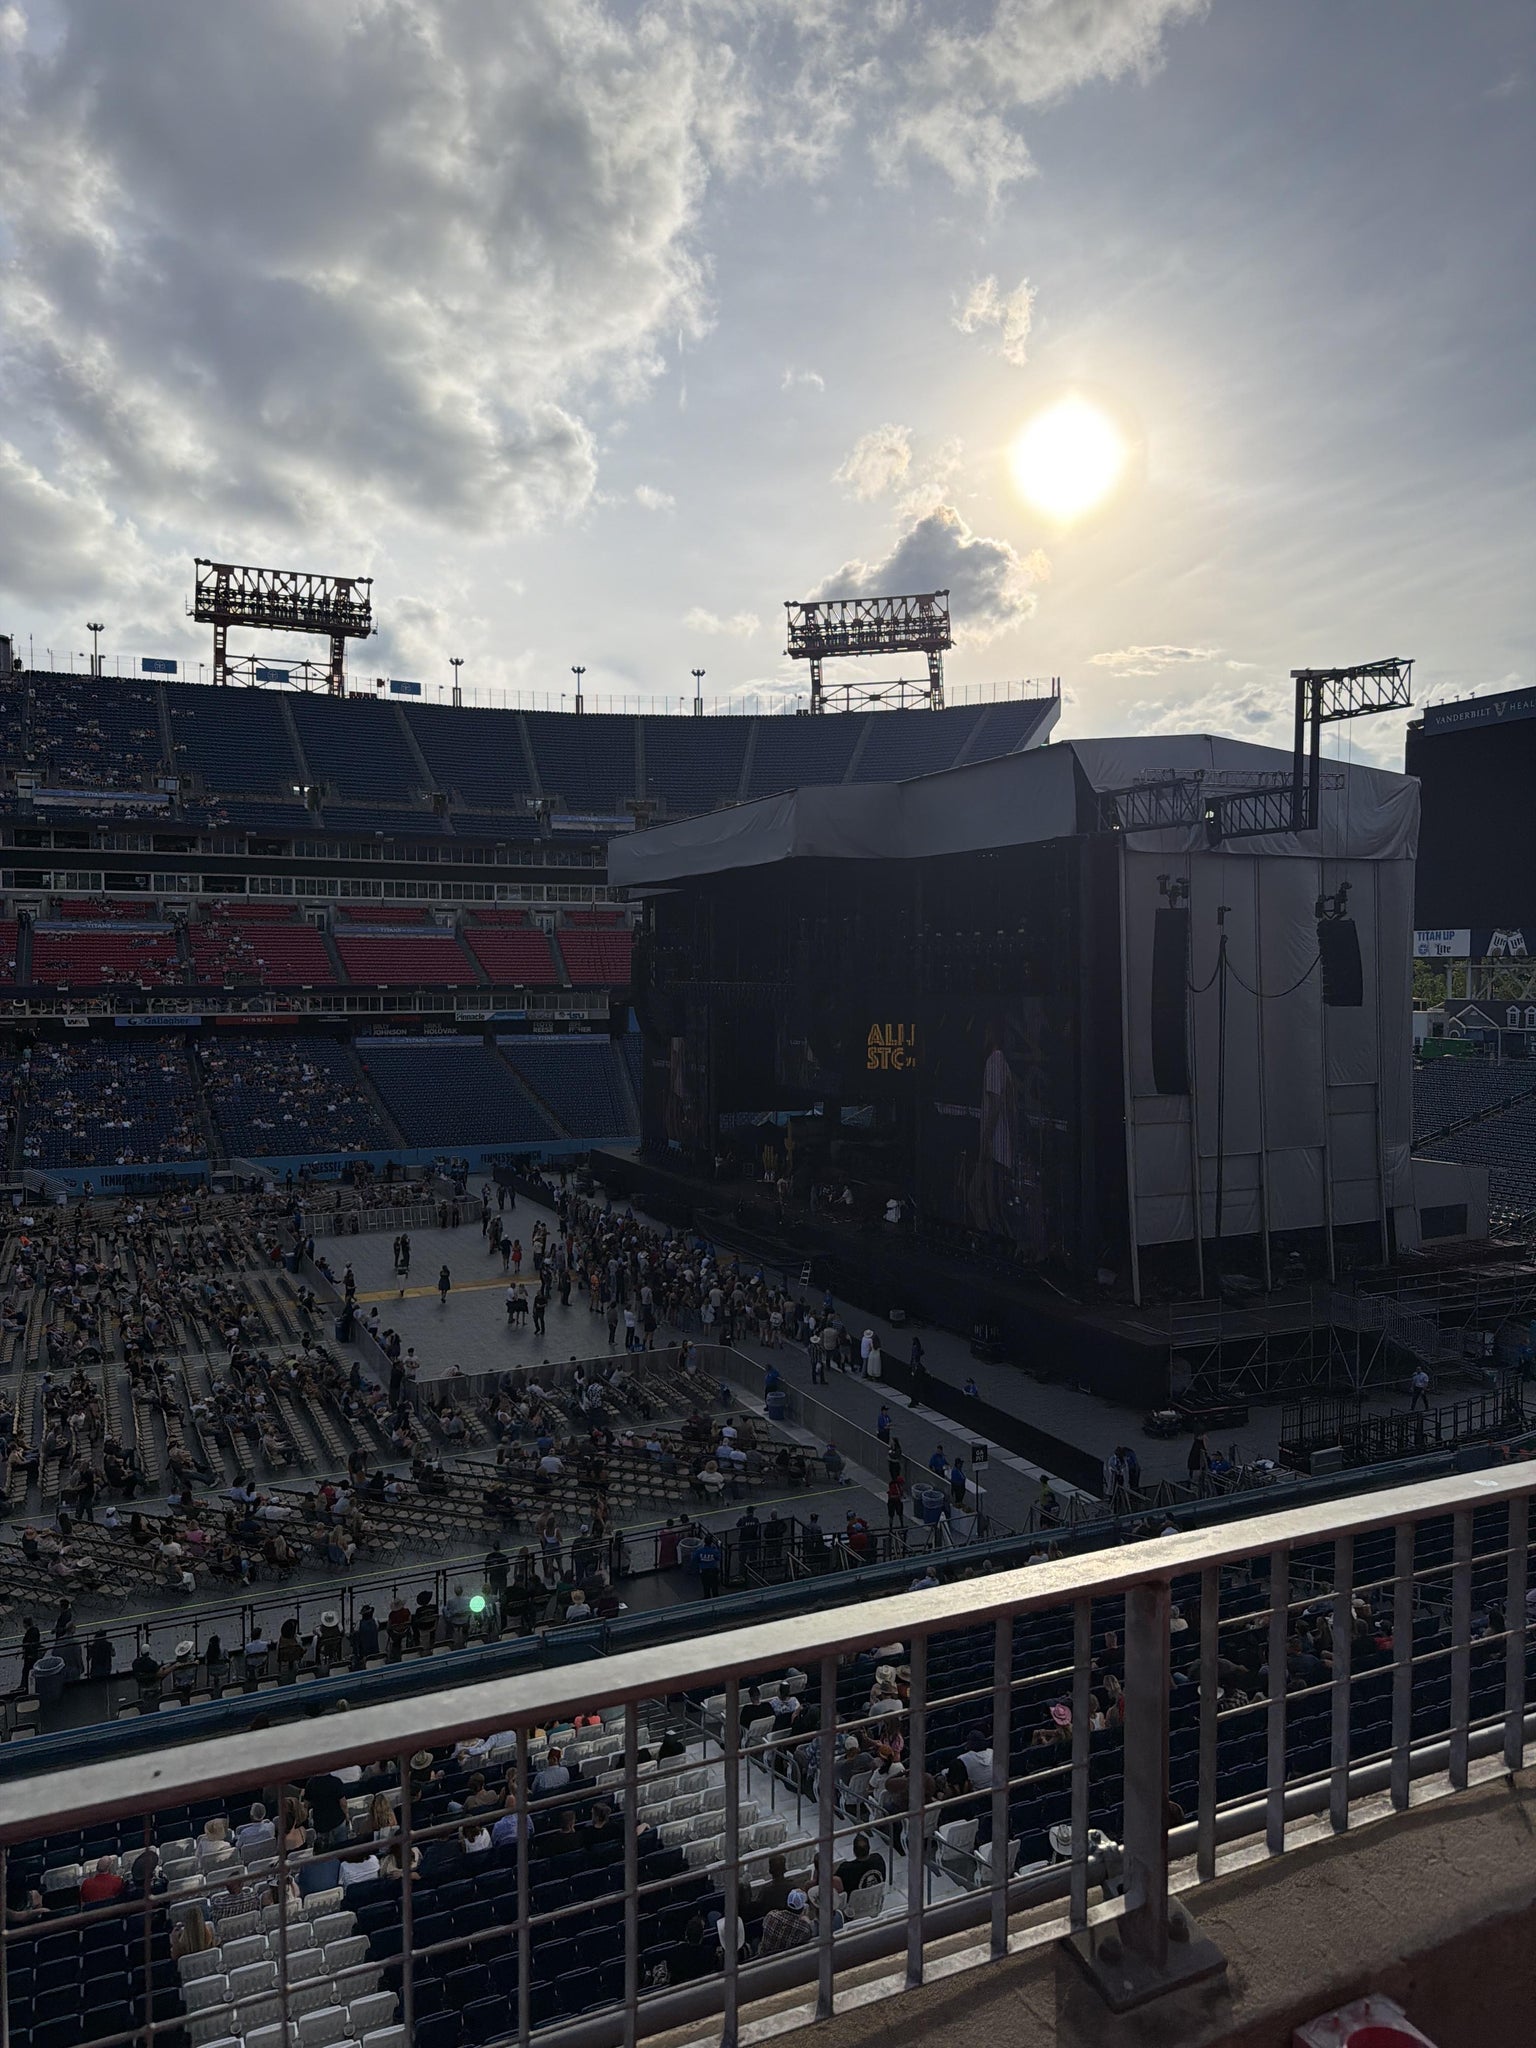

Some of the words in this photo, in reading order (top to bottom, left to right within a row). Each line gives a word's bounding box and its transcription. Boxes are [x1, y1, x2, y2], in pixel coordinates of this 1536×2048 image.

[1436, 708, 1491, 725] VANDERBILT
[1417, 931, 1441, 941] TITAN
[1443, 930, 1455, 940] UP
[1435, 943, 1451, 955] Lite
[143, 1016, 190, 1026] Gallagher
[456, 1012, 486, 1021] Pinnacle
